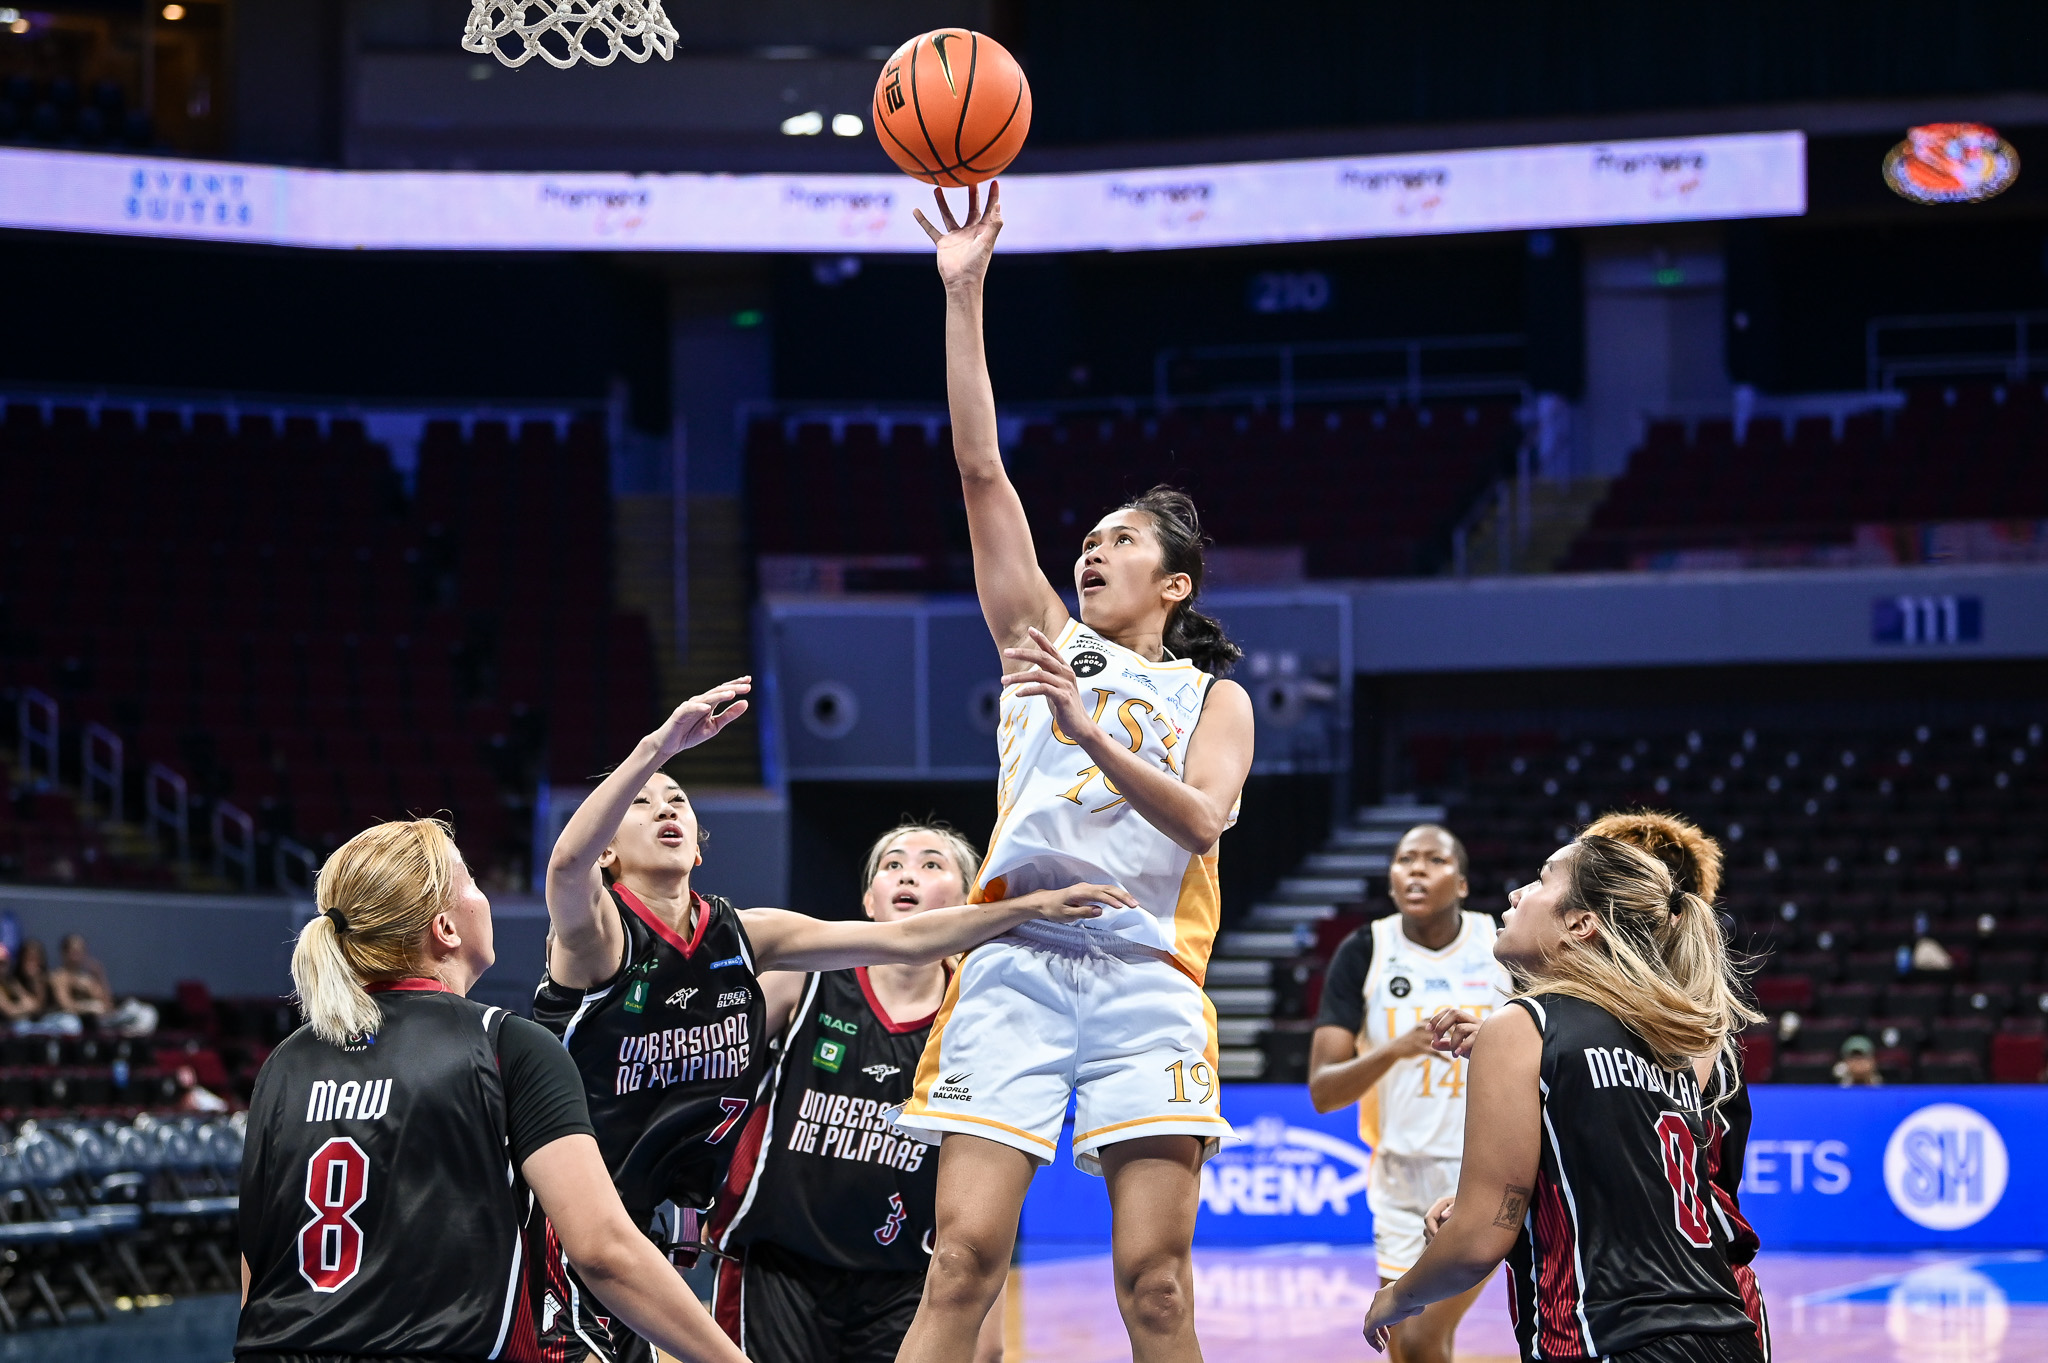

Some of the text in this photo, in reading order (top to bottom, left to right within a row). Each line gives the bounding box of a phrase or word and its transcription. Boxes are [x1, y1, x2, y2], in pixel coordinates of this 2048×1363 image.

[124, 197, 252, 226] SUITES
[1252, 271, 1329, 311] 210
[1898, 595, 1957, 645] 111
[1073, 659, 1104, 668] AURORA
[716, 998, 747, 1009] BLAZE
[718, 990, 746, 1001] FIBER
[818, 1012, 858, 1036] NAC
[616, 1062, 645, 1096] NG
[932, 1091, 973, 1102] BALANCE
[938, 1085, 970, 1094] WORLD
[1164, 1059, 1215, 1105] 19
[1415, 1058, 1465, 1099] 14
[306, 1078, 393, 1123] MAW
[704, 1097, 749, 1145] 7
[787, 1119, 821, 1154] NG
[1653, 1110, 1713, 1249] 0
[1900, 1125, 1986, 1208] SM
[297, 1136, 371, 1294] 8
